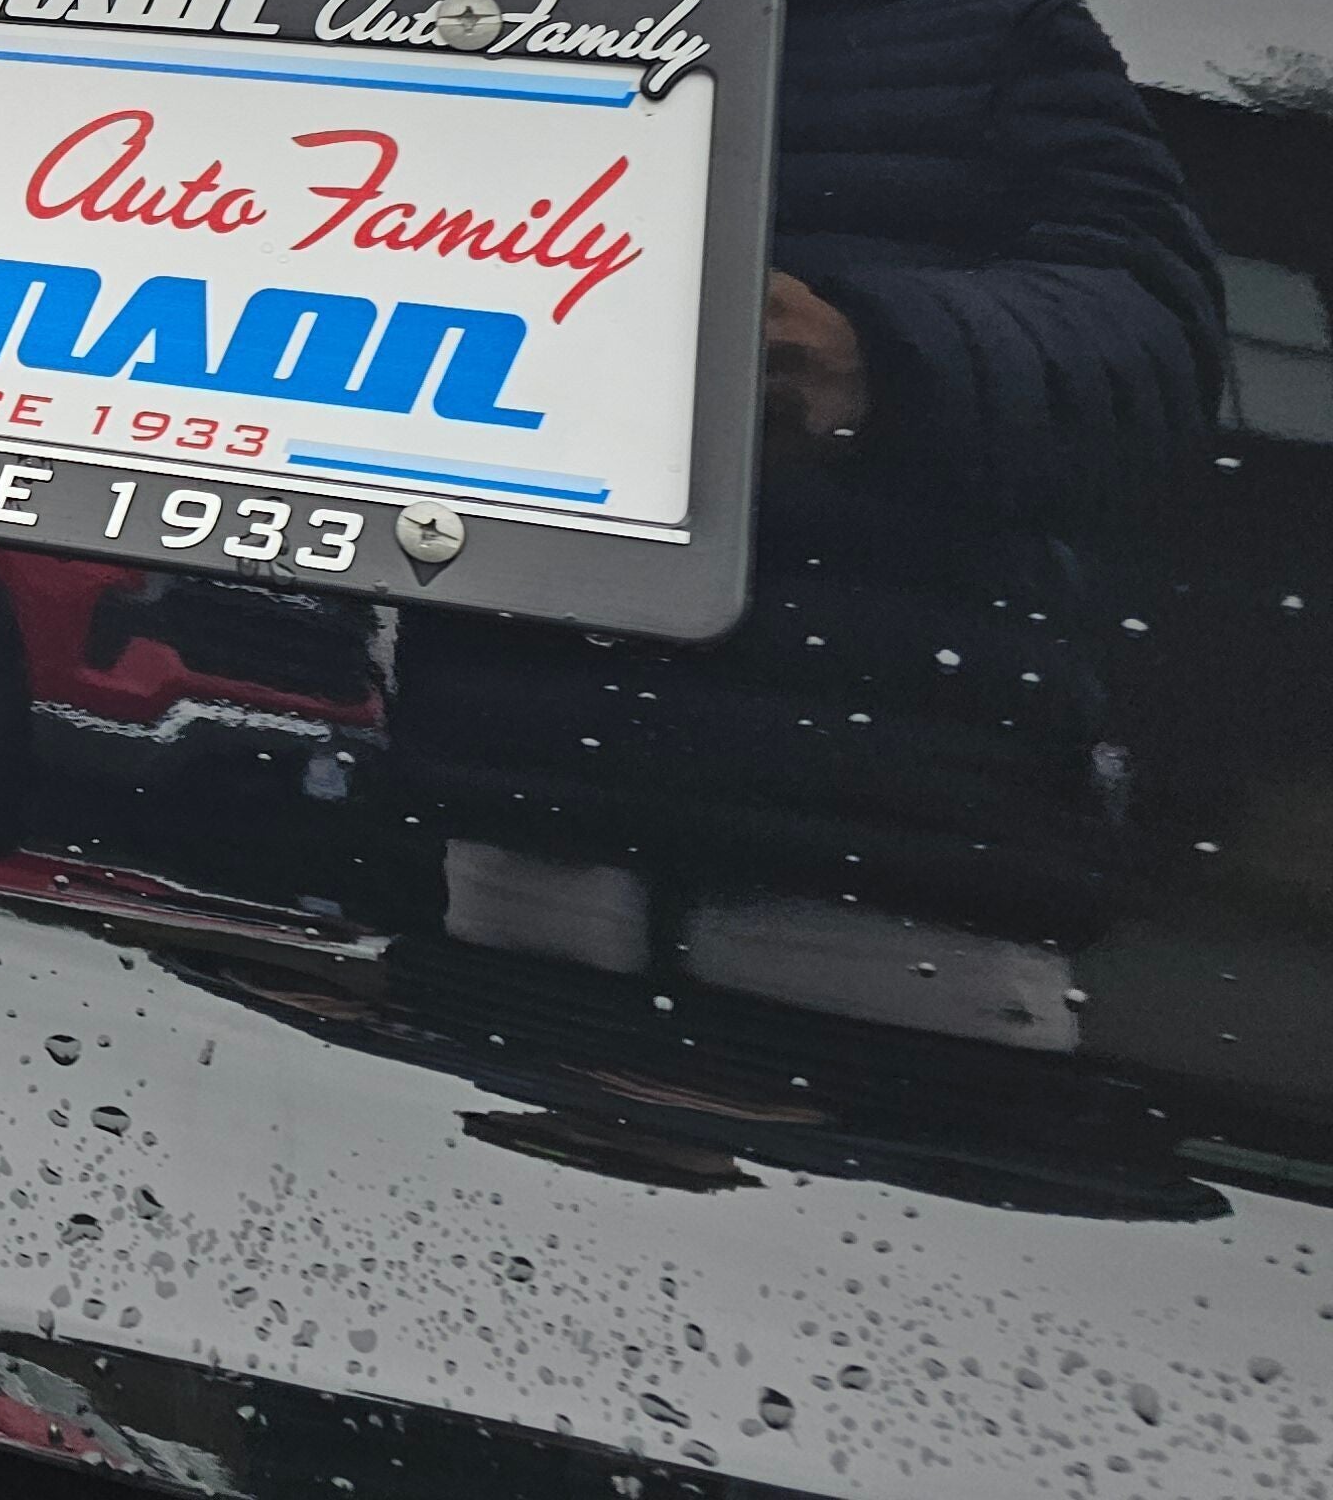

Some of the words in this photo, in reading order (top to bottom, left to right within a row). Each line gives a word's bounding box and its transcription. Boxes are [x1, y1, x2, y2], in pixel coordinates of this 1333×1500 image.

[23, 110, 267, 235] Auto
[289, 128, 644, 325] Family
[91, 405, 269, 457] 1933
[103, 481, 365, 572] 1933
